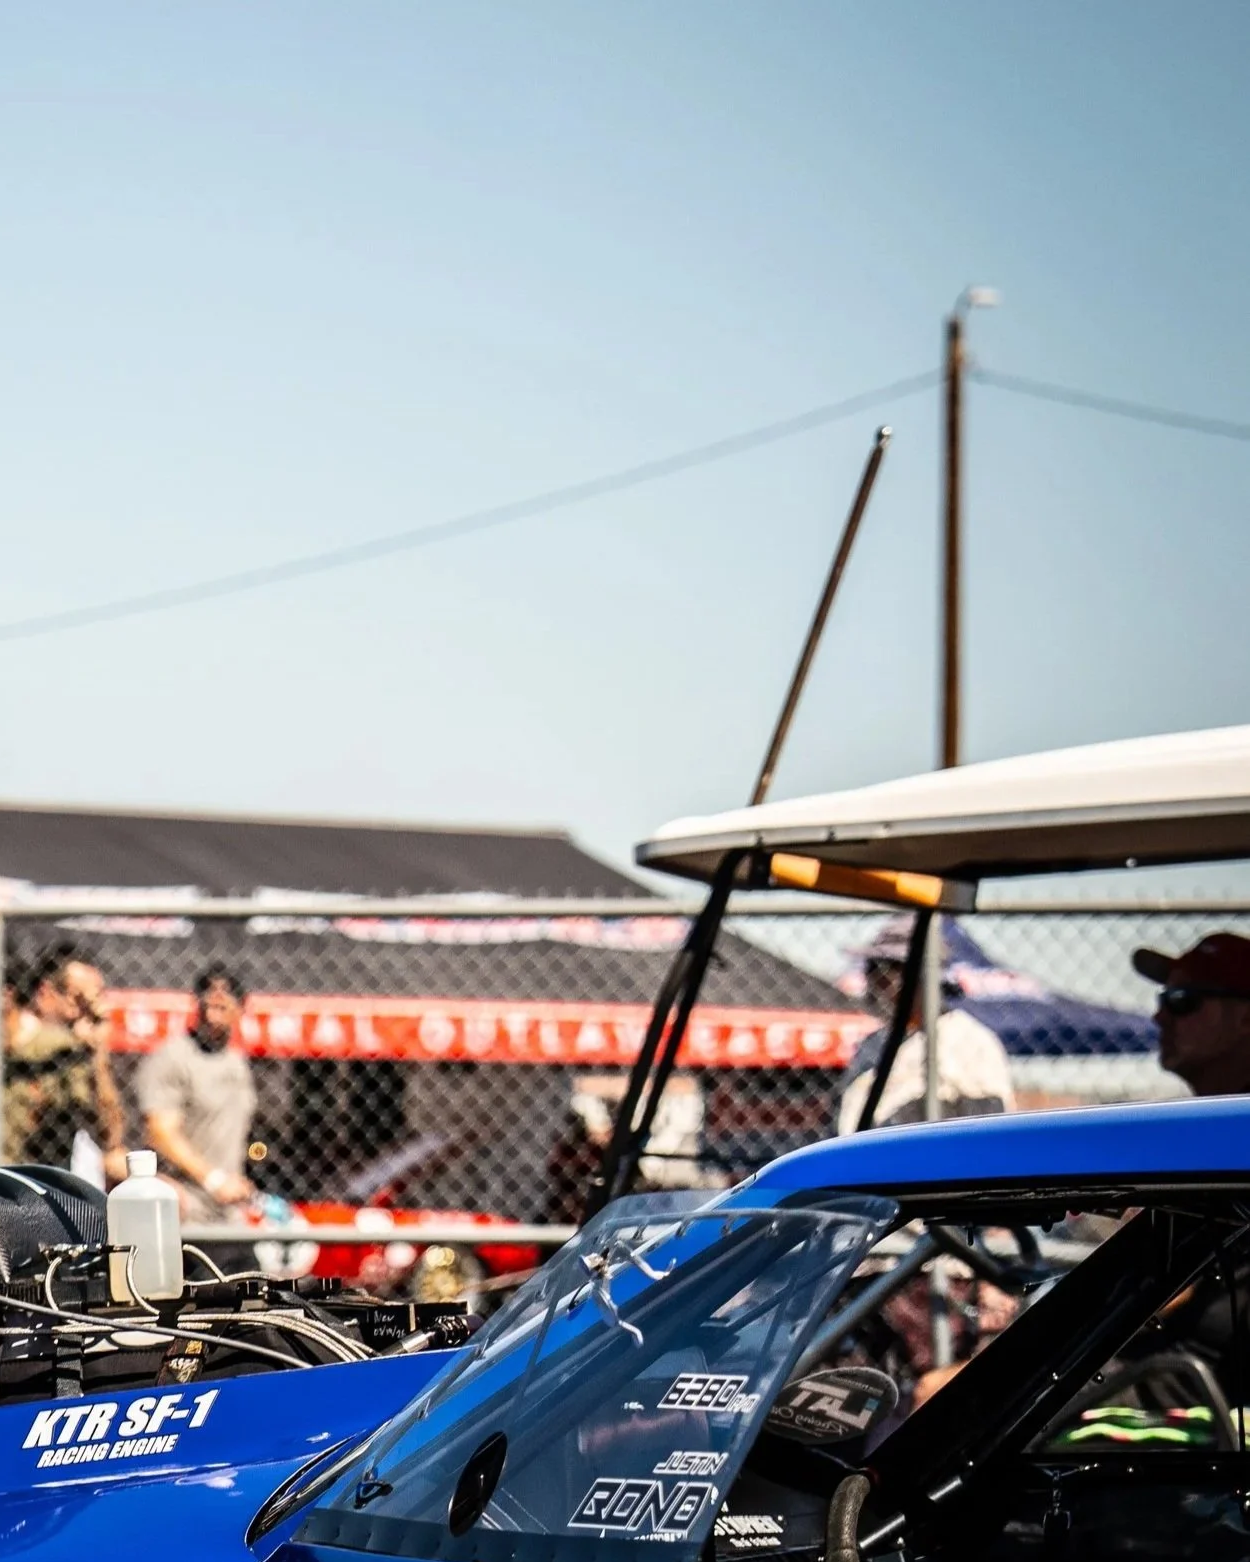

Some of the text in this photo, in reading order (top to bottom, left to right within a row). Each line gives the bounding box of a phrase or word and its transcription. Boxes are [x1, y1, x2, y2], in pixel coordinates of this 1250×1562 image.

[22, 1387, 220, 1449] KTR SF-1
[36, 1433, 180, 1469] RACING ENGINE
[652, 1451, 729, 1475] JUSTIN
